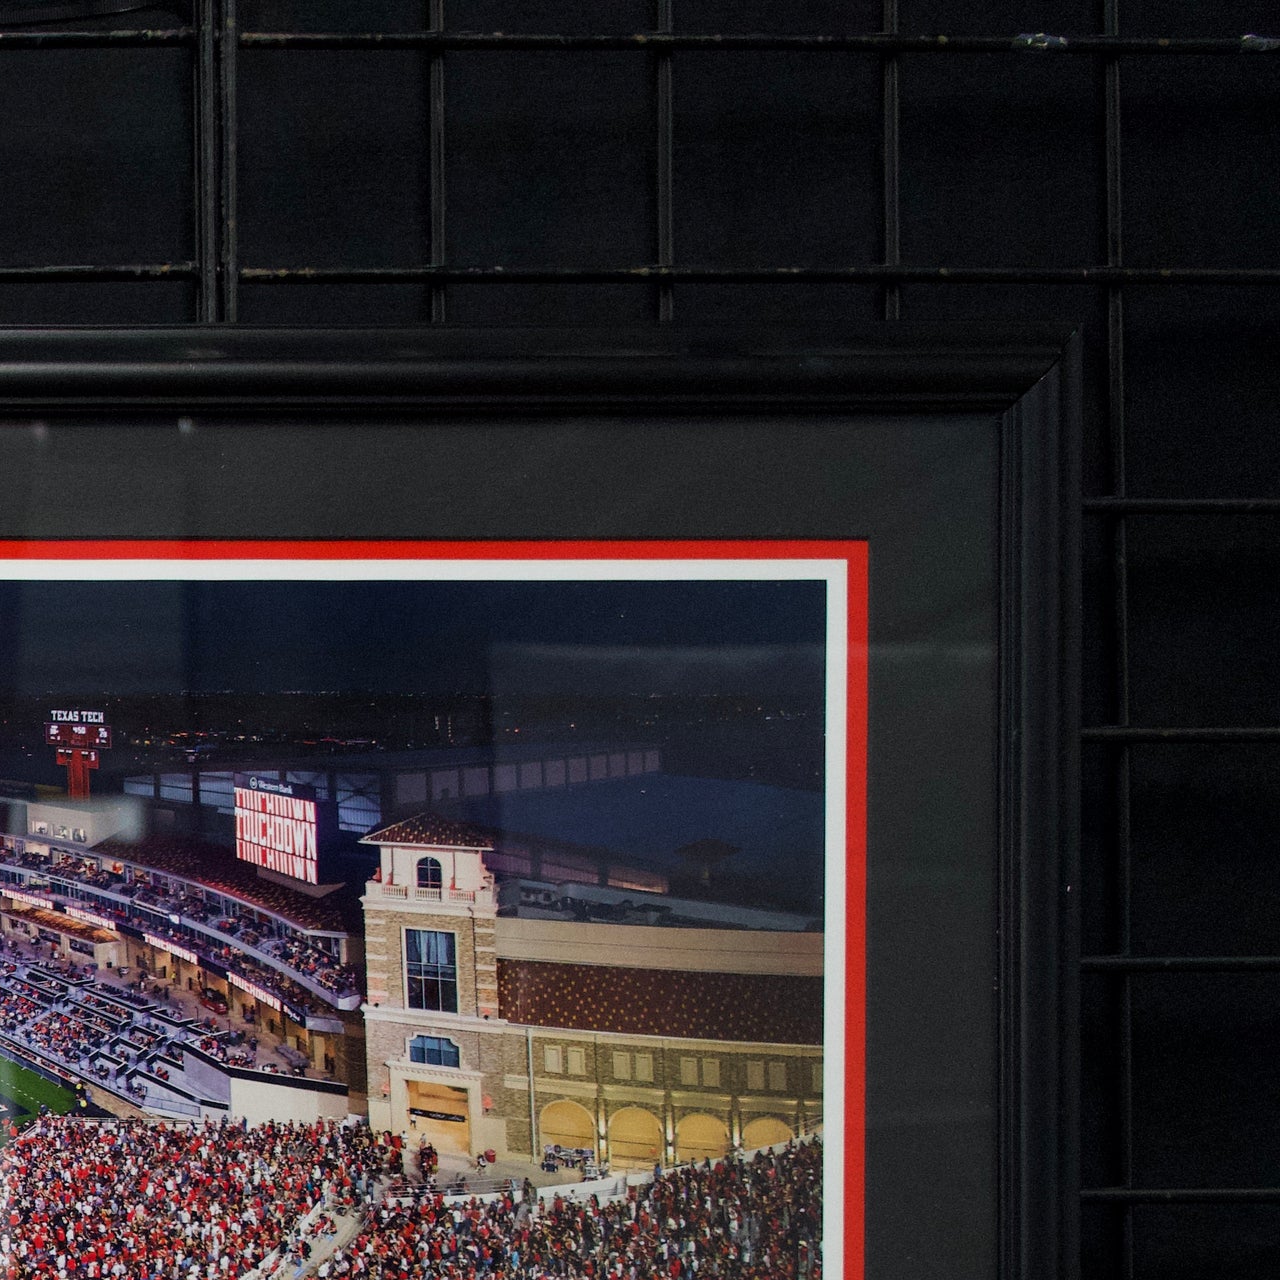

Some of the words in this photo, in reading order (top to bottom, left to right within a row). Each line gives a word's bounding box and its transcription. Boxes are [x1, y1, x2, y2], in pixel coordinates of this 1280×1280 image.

[51, 710, 79, 721] TEXAS
[81, 711, 104, 723] TECH
[235, 807, 316, 861] TOUCHDOWN
[226, 971, 281, 1012] TOUCHDOWN
